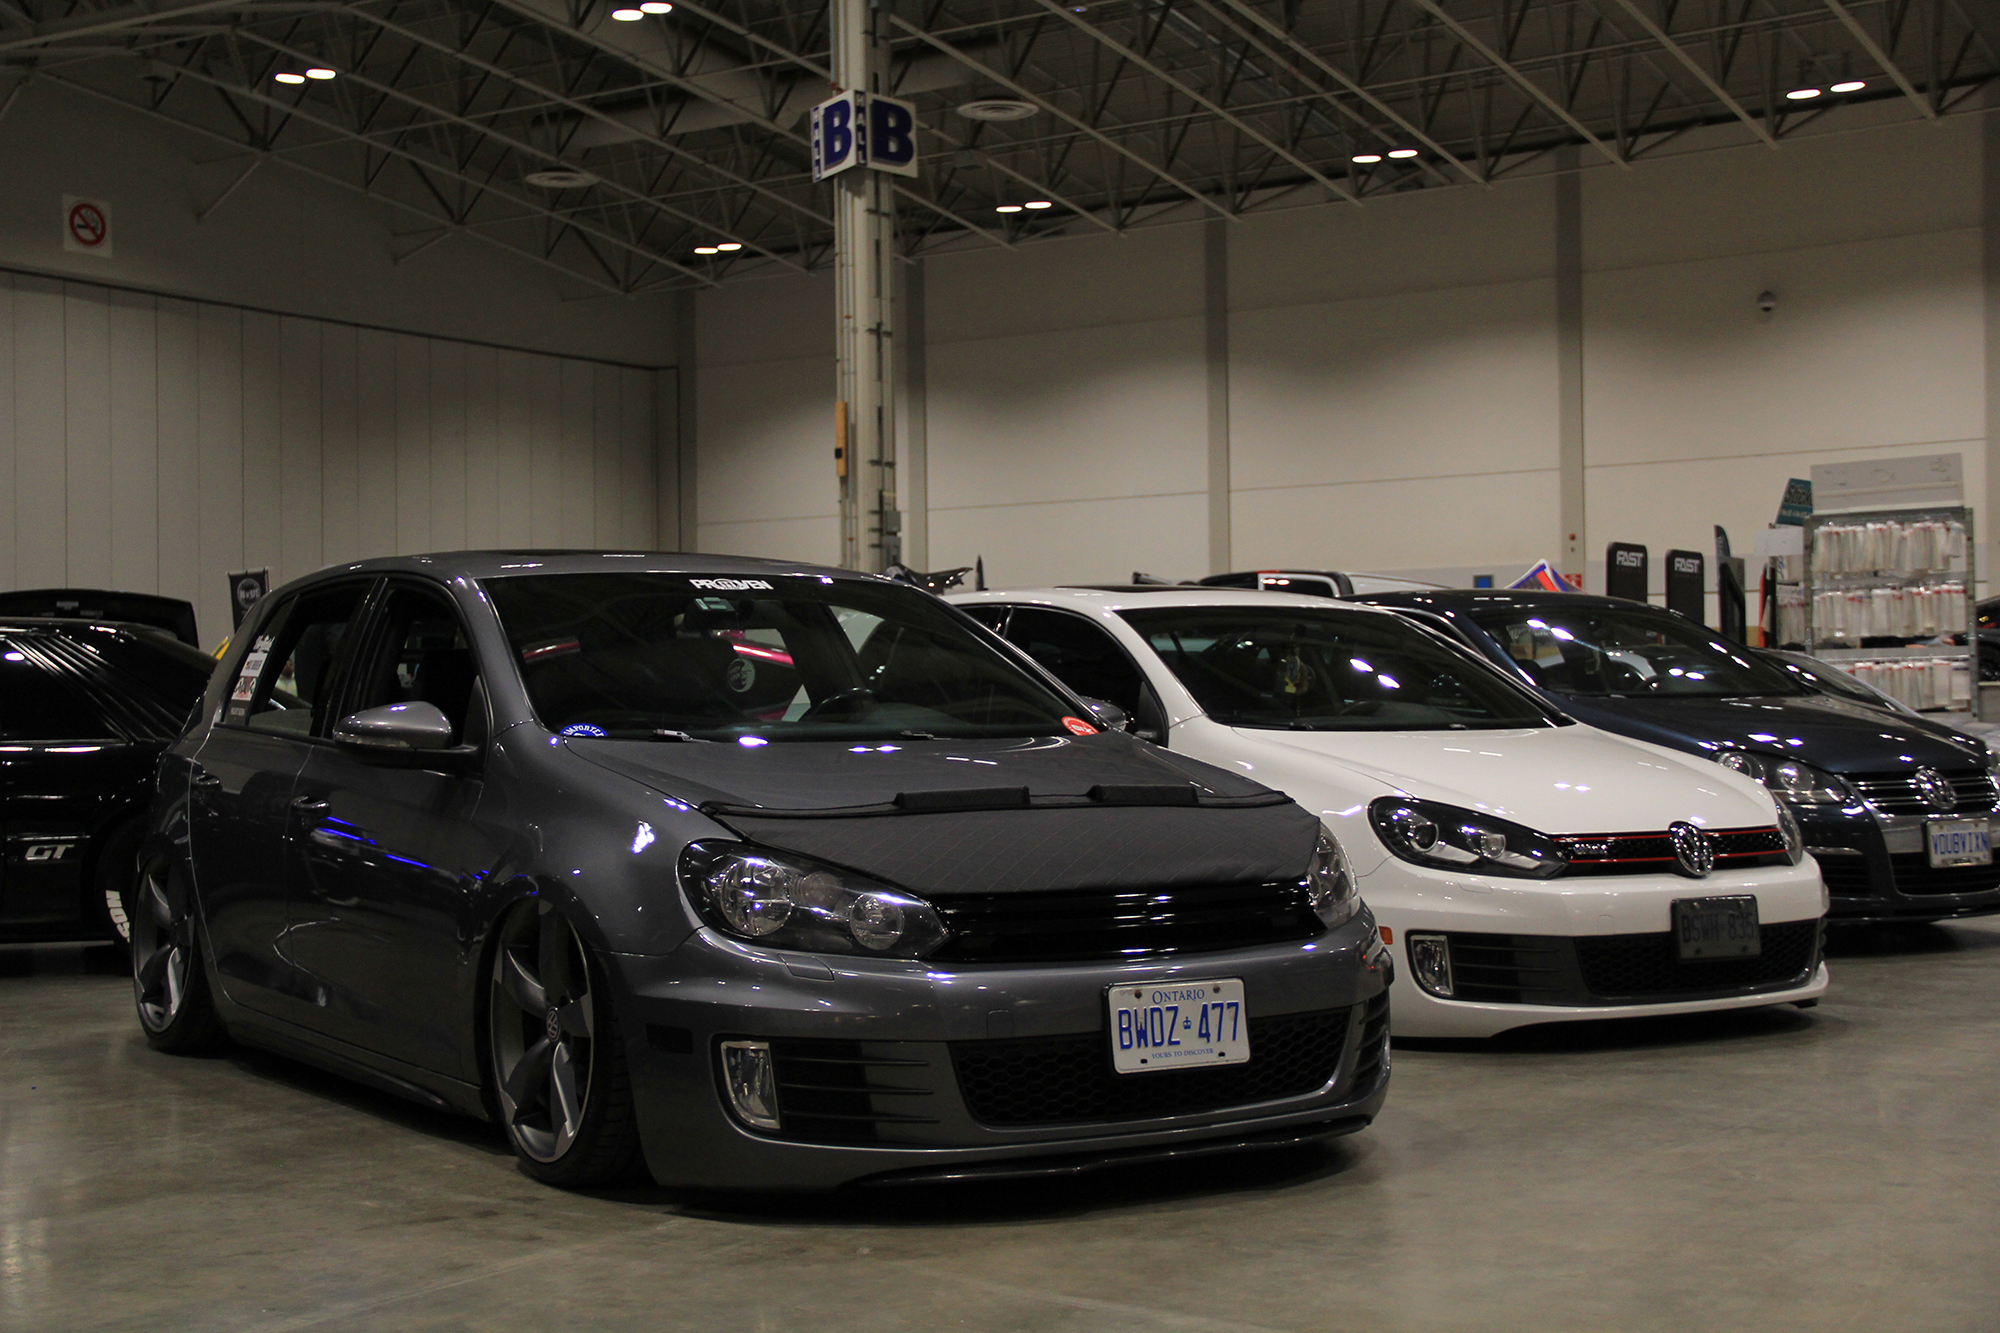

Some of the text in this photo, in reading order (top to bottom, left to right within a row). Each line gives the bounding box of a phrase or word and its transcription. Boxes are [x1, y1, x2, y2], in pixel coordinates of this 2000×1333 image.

[824, 100, 852, 167] B
[872, 99, 914, 163] B
[1616, 551, 1644, 567] FAST
[1674, 557, 1700, 574] FAST
[25, 844, 75, 861] GT
[1152, 989, 1205, 1004] ONTARIO
[1118, 1001, 1239, 1049] BWDZ 477
[1184, 1048, 1214, 1057] DISCOVER
